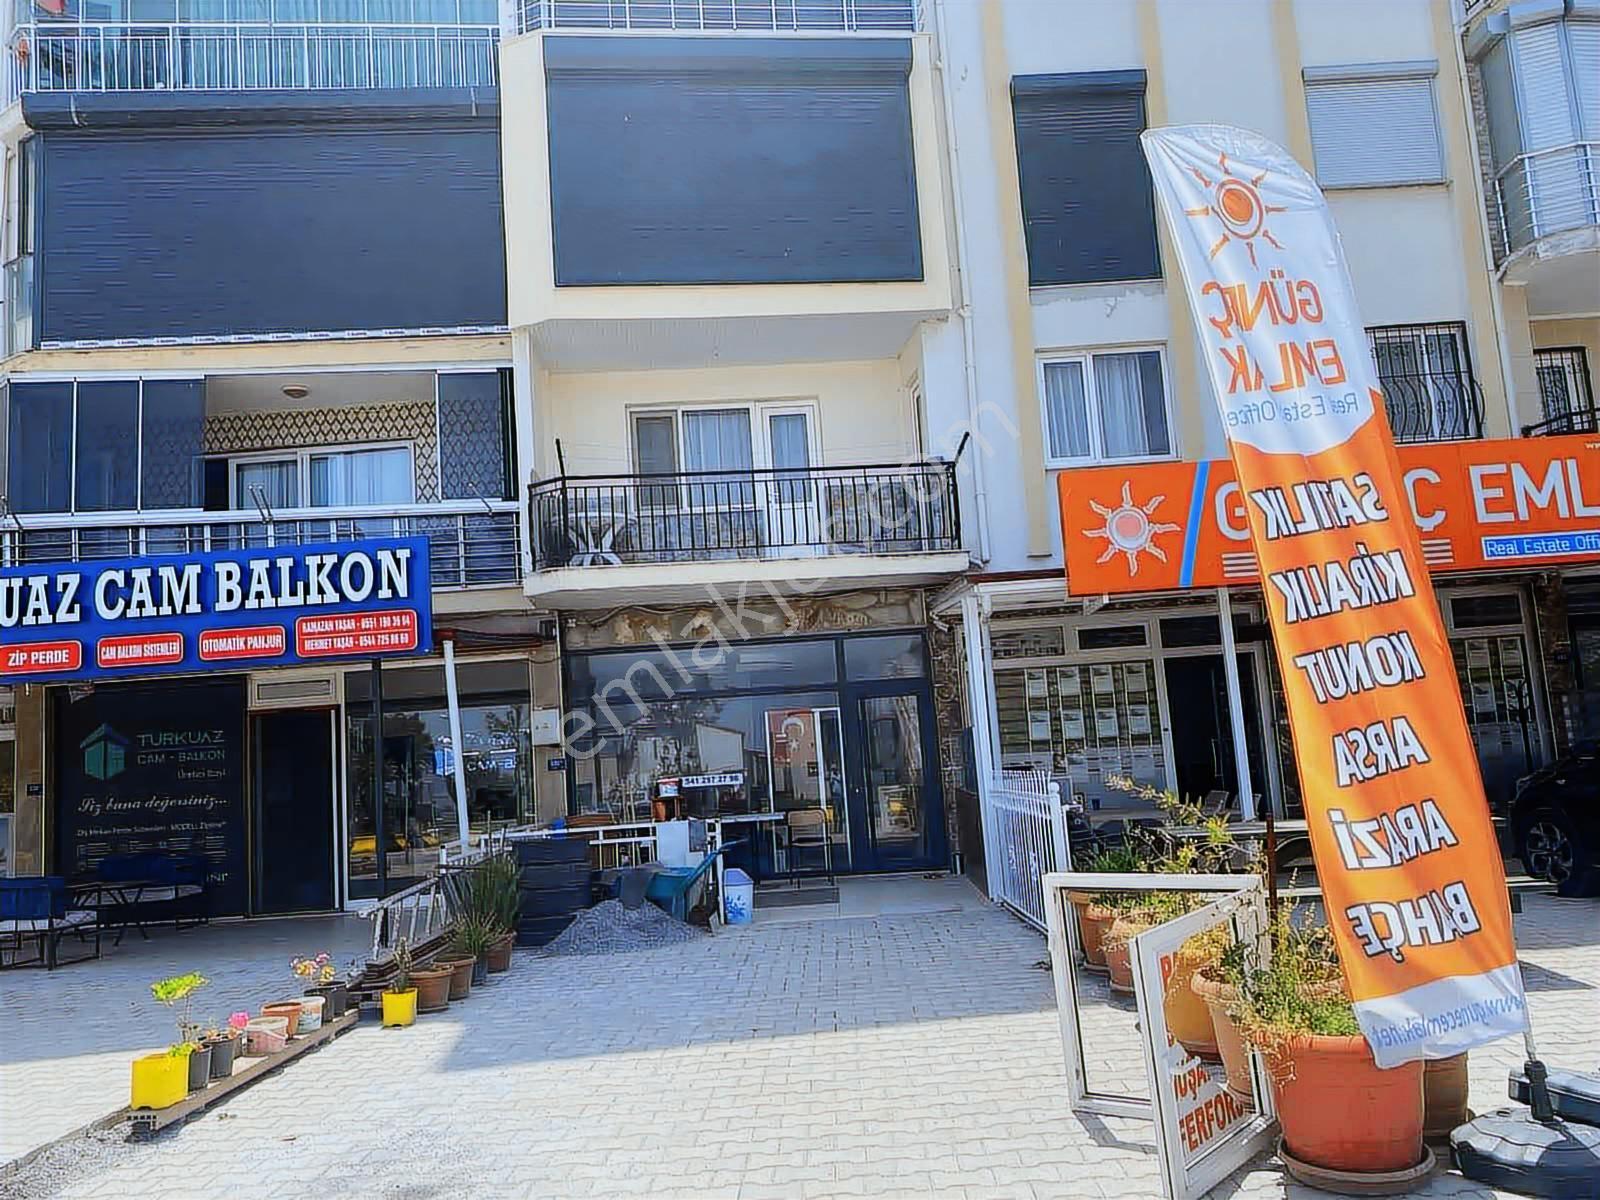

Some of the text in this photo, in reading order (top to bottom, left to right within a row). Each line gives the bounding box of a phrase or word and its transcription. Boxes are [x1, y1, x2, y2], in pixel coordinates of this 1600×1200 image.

[1486, 540, 1518, 556] Real
[1523, 538, 1571, 554] Estate
[0, 548, 411, 628] UAZ CAM BALKON
[202, 633, 283, 653] OTOMATİK PANJUR
[8, 649, 70, 667] ZİP PERDE
[136, 730, 224, 747] TURKUAZ
[137, 752, 166, 766] CAM
[178, 749, 224, 762] BALKON
